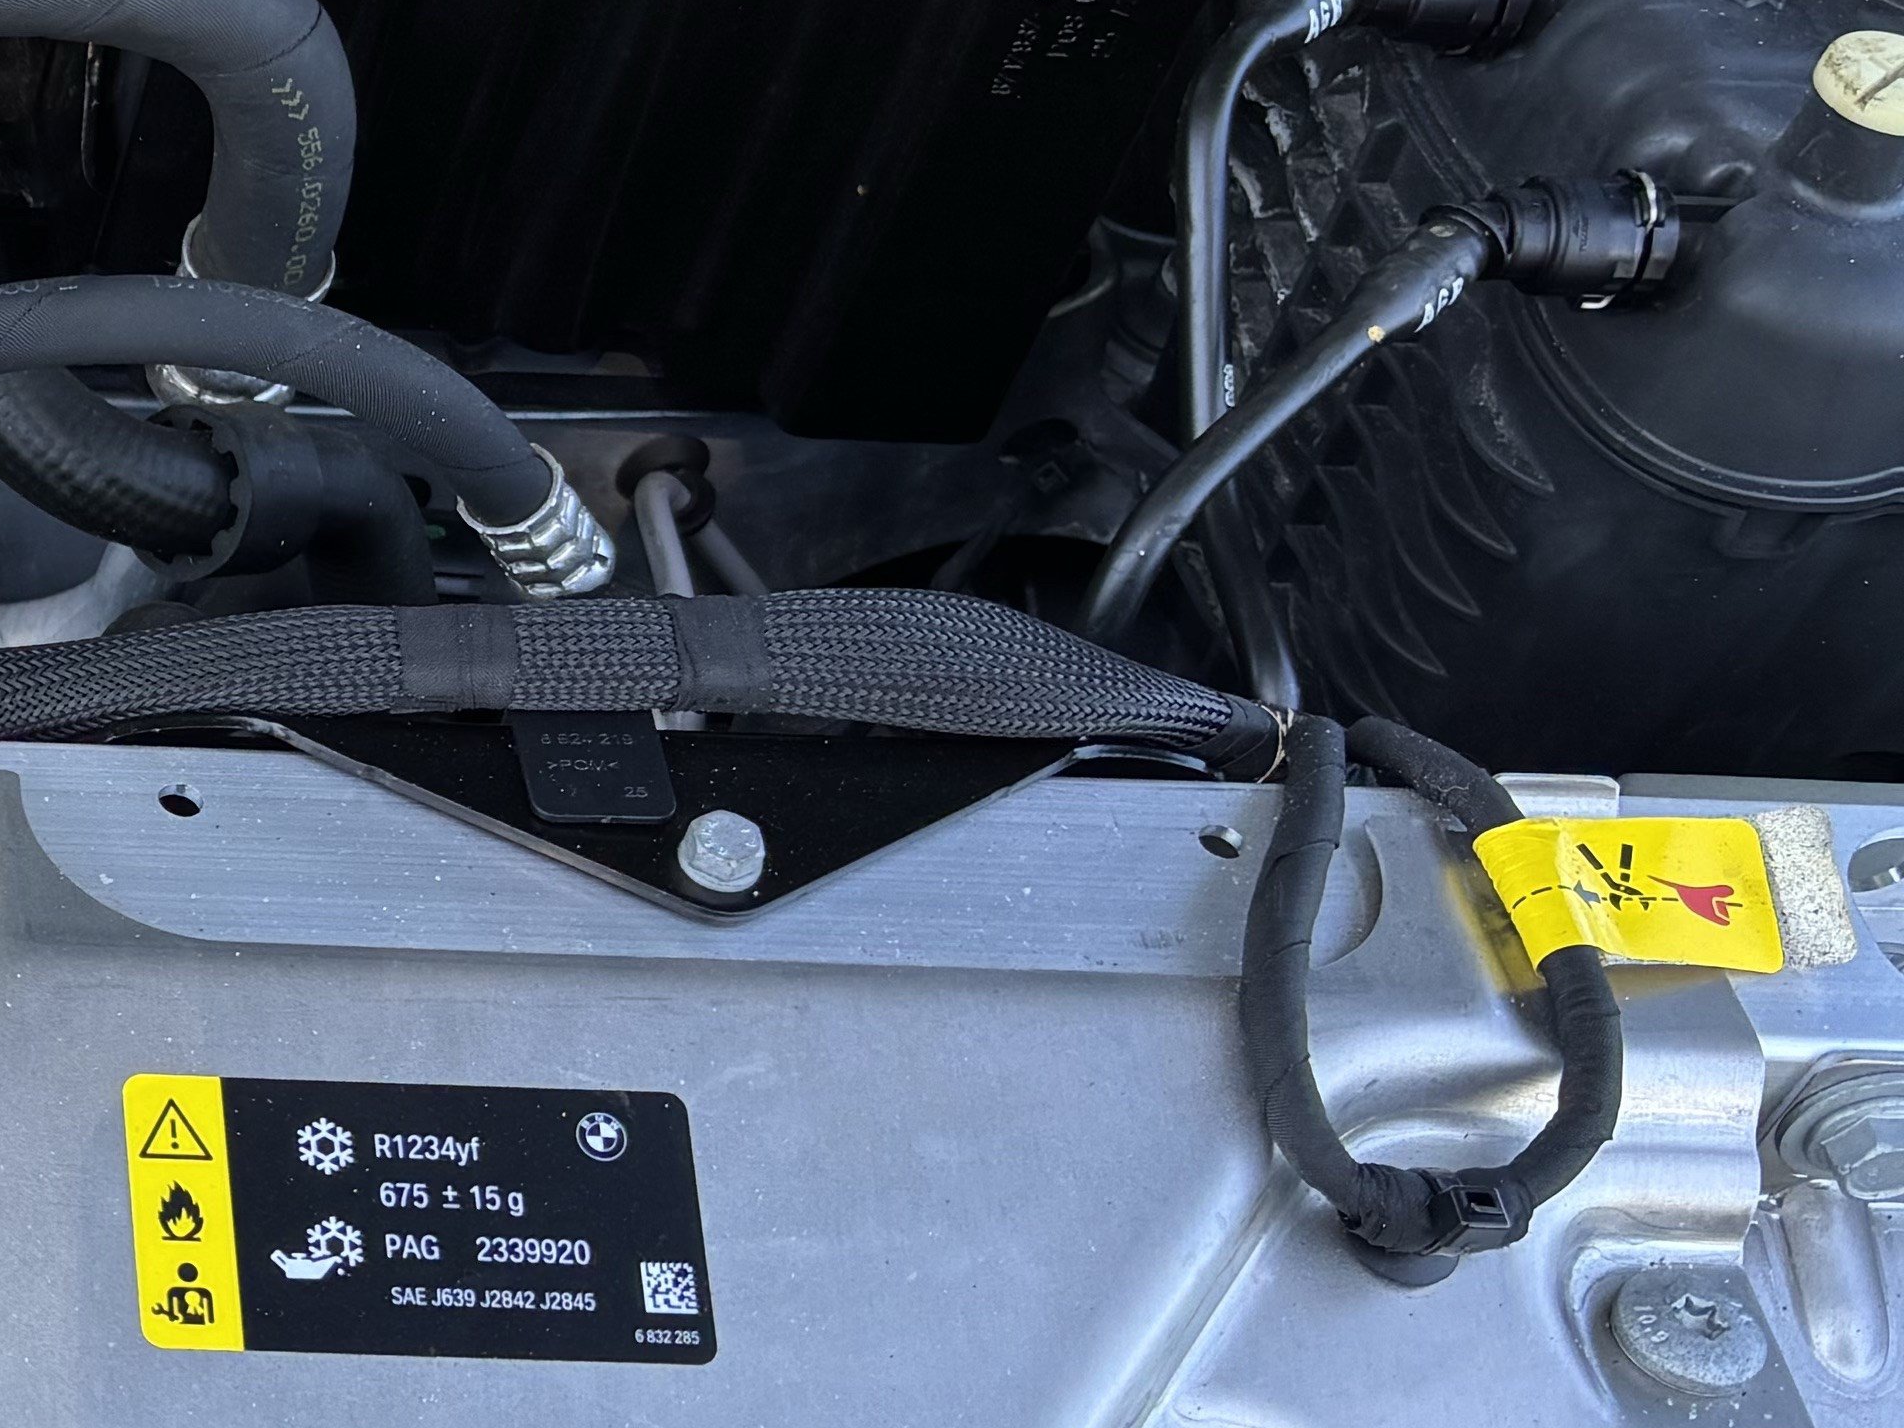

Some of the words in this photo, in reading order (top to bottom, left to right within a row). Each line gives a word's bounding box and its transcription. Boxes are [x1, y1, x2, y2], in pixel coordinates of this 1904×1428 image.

[373, 1132, 481, 1167] R1234yf
[379, 1181, 430, 1209] 675
[441, 1185, 461, 1209] ±
[468, 1184, 501, 1211] 15
[507, 1190, 525, 1217] g
[384, 1233, 441, 1261] PAG
[475, 1236, 591, 1266] 2339920
[390, 1286, 427, 1306] SAE
[431, 1287, 476, 1308] J639
[479, 1289, 536, 1310] J2842
[539, 1290, 597, 1312] J2845
[634, 1328, 645, 1344] 6
[646, 1329, 672, 1345] 832
[673, 1329, 700, 1346] 285
